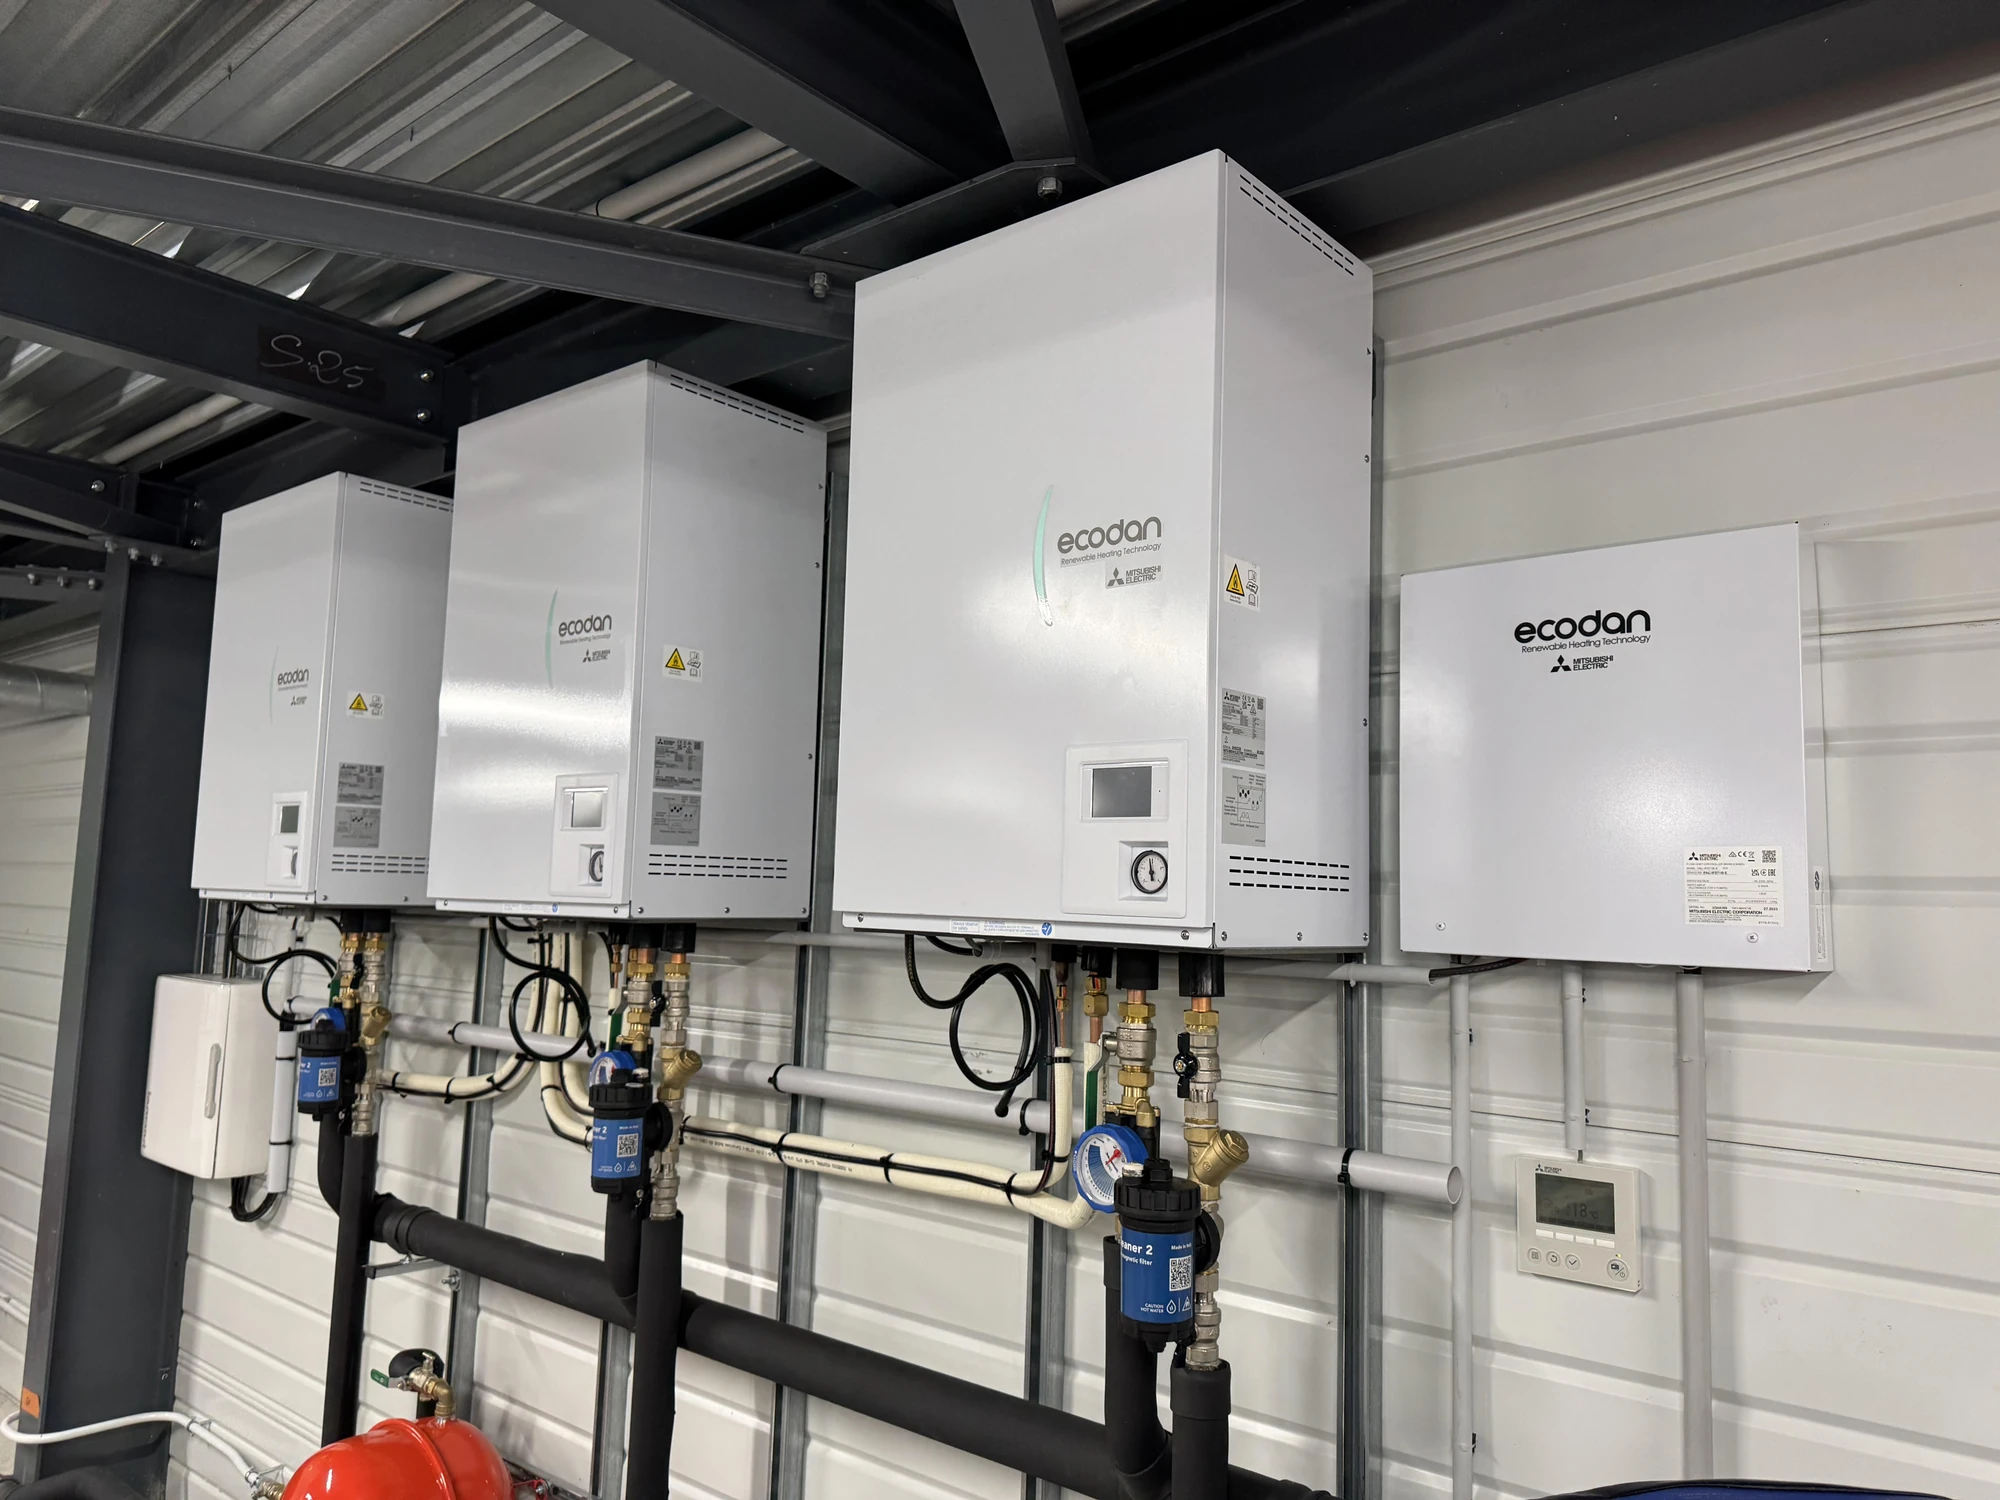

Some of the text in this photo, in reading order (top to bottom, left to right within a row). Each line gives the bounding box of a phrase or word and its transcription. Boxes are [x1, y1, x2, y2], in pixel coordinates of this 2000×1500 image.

[1057, 516, 1162, 554] ecodan
[1061, 542, 1162, 566] Renewable Heating Technology
[1125, 565, 1161, 577] MITSUBISHI
[1125, 573, 1156, 584] ELECTRIC
[558, 614, 612, 637] ecodan
[1514, 609, 1651, 644] ecodan
[1521, 634, 1651, 654] Renewable Heating Technology
[1573, 655, 1614, 665] MITSUBISHI
[1573, 662, 1608, 671] ELECTRIC
[277, 668, 310, 685] ecodan
[602, 1125, 607, 1134] 2
[1145, 1244, 1153, 1256] 2
[1140, 1257, 1153, 1266] filter
